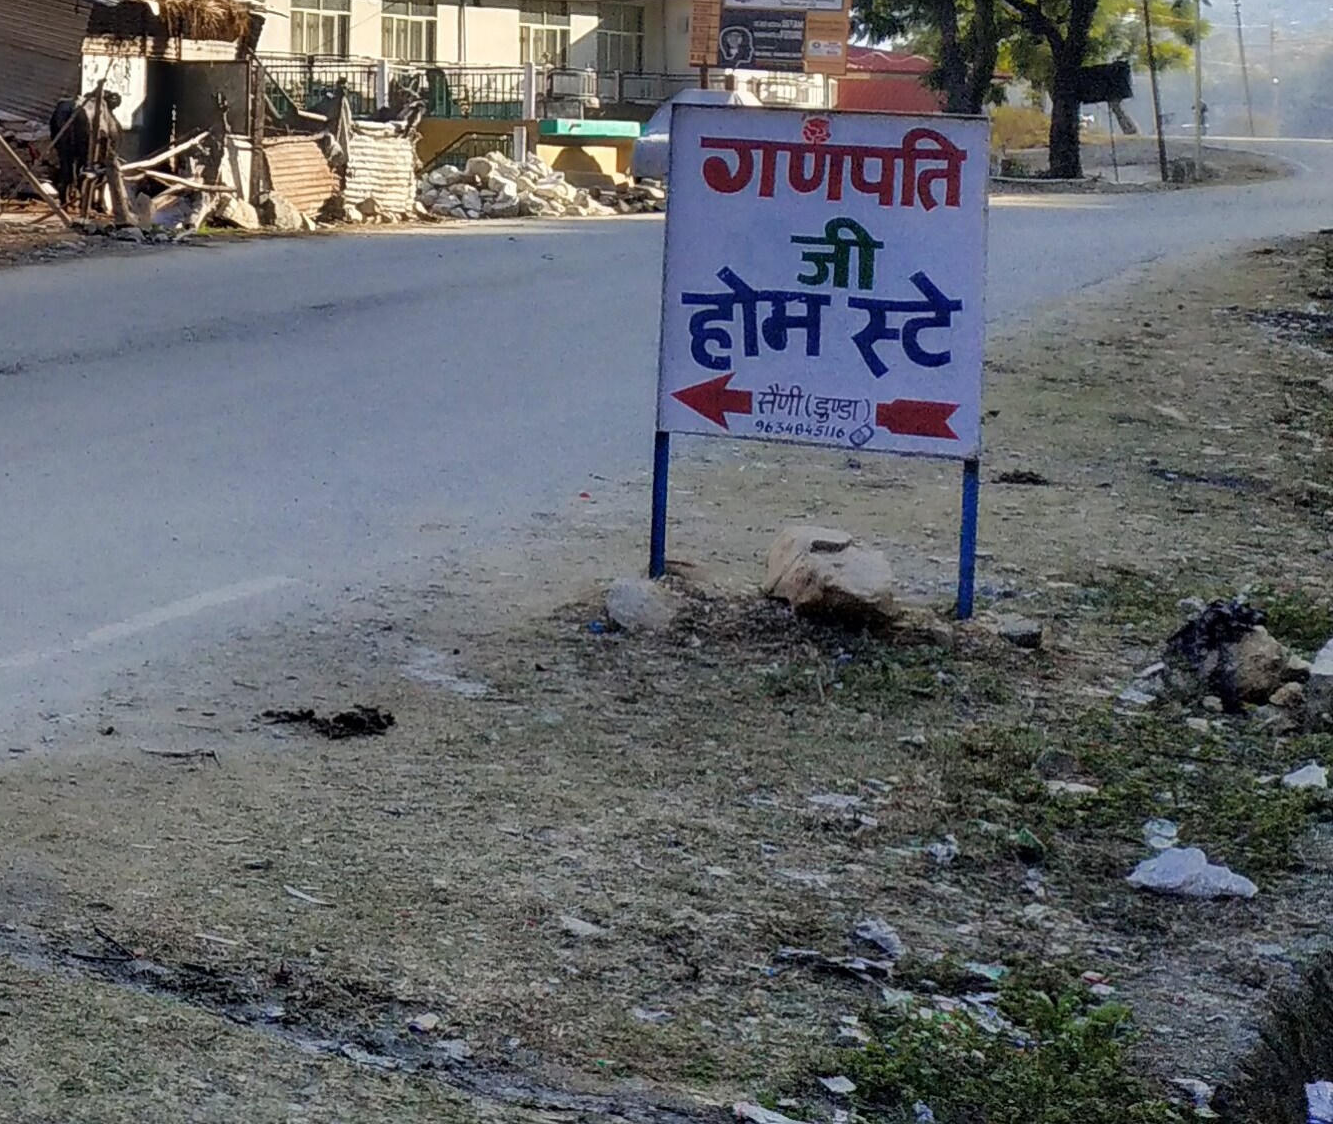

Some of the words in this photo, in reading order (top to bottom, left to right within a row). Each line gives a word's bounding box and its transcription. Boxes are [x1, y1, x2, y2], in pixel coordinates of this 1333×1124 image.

[699, 128, 967, 211] गणपति
[790, 217, 884, 290] जी
[681, 266, 831, 370] होम
[848, 270, 963, 378] स्टे
[755, 420, 846, 439] 9634845116
